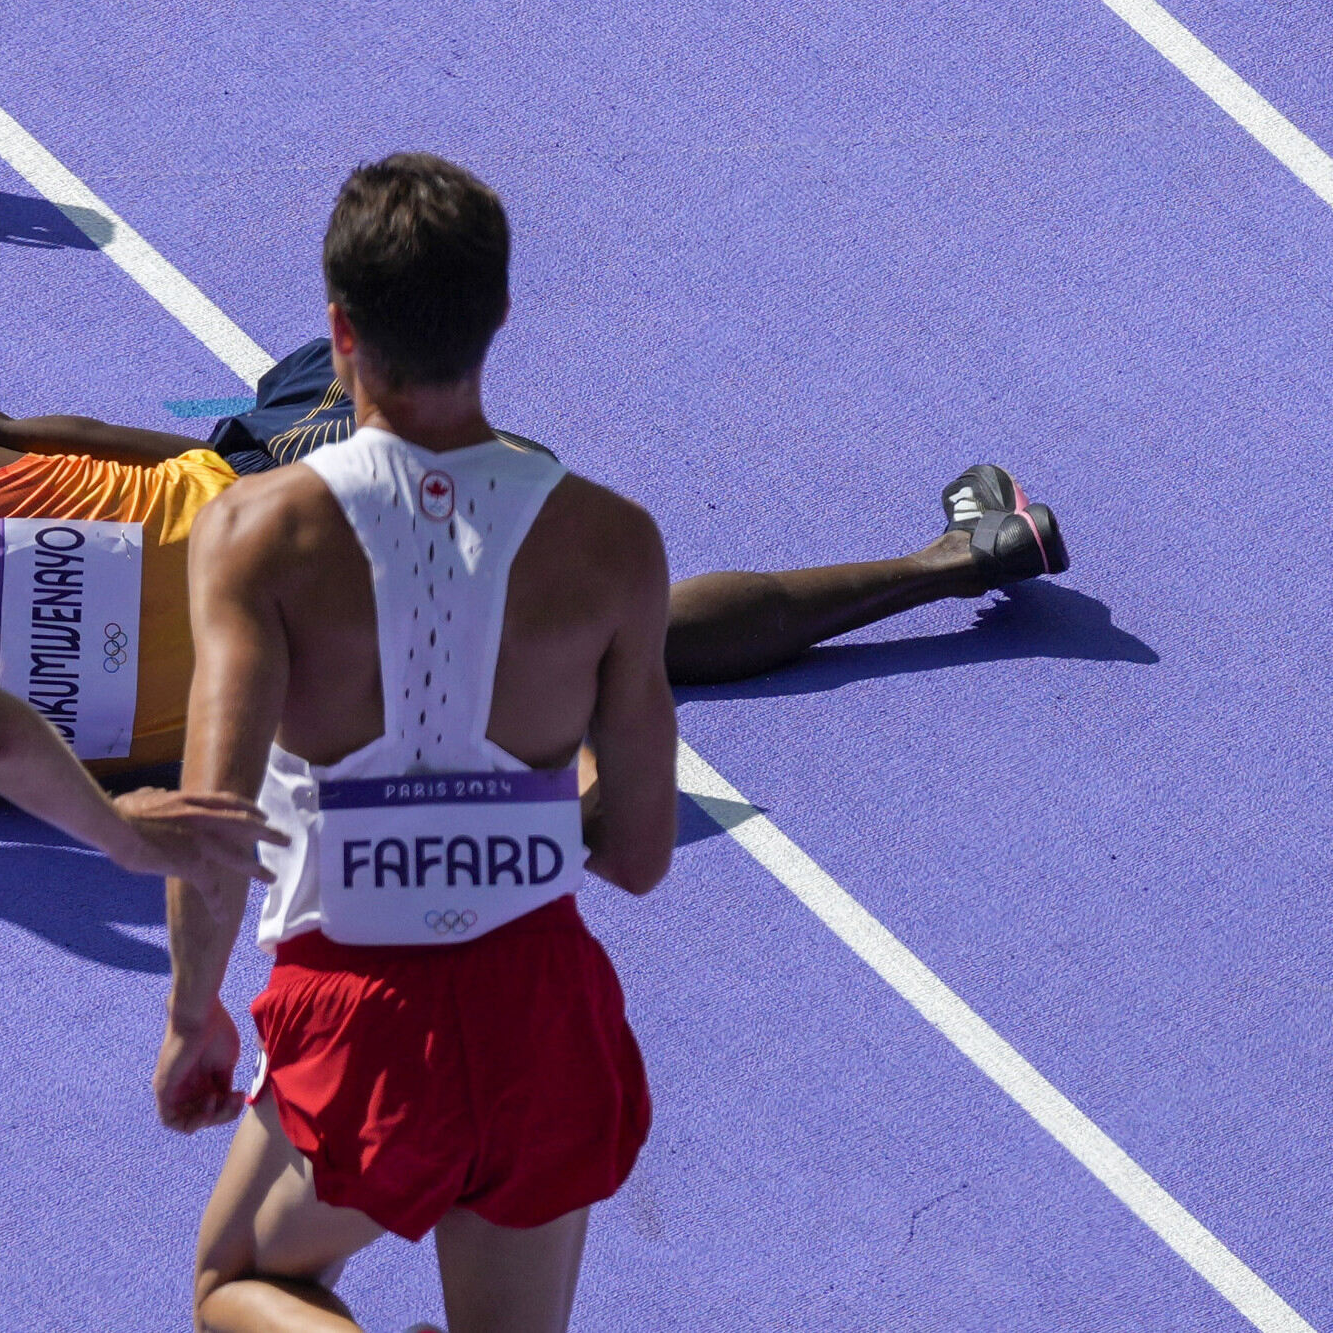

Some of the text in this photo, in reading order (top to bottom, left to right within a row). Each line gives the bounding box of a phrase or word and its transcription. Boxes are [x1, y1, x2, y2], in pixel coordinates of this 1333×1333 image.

[29, 526, 86, 745] IKUMWENAYO
[385, 778, 512, 799] PARIS 2024
[342, 834, 565, 889] FAFARD
